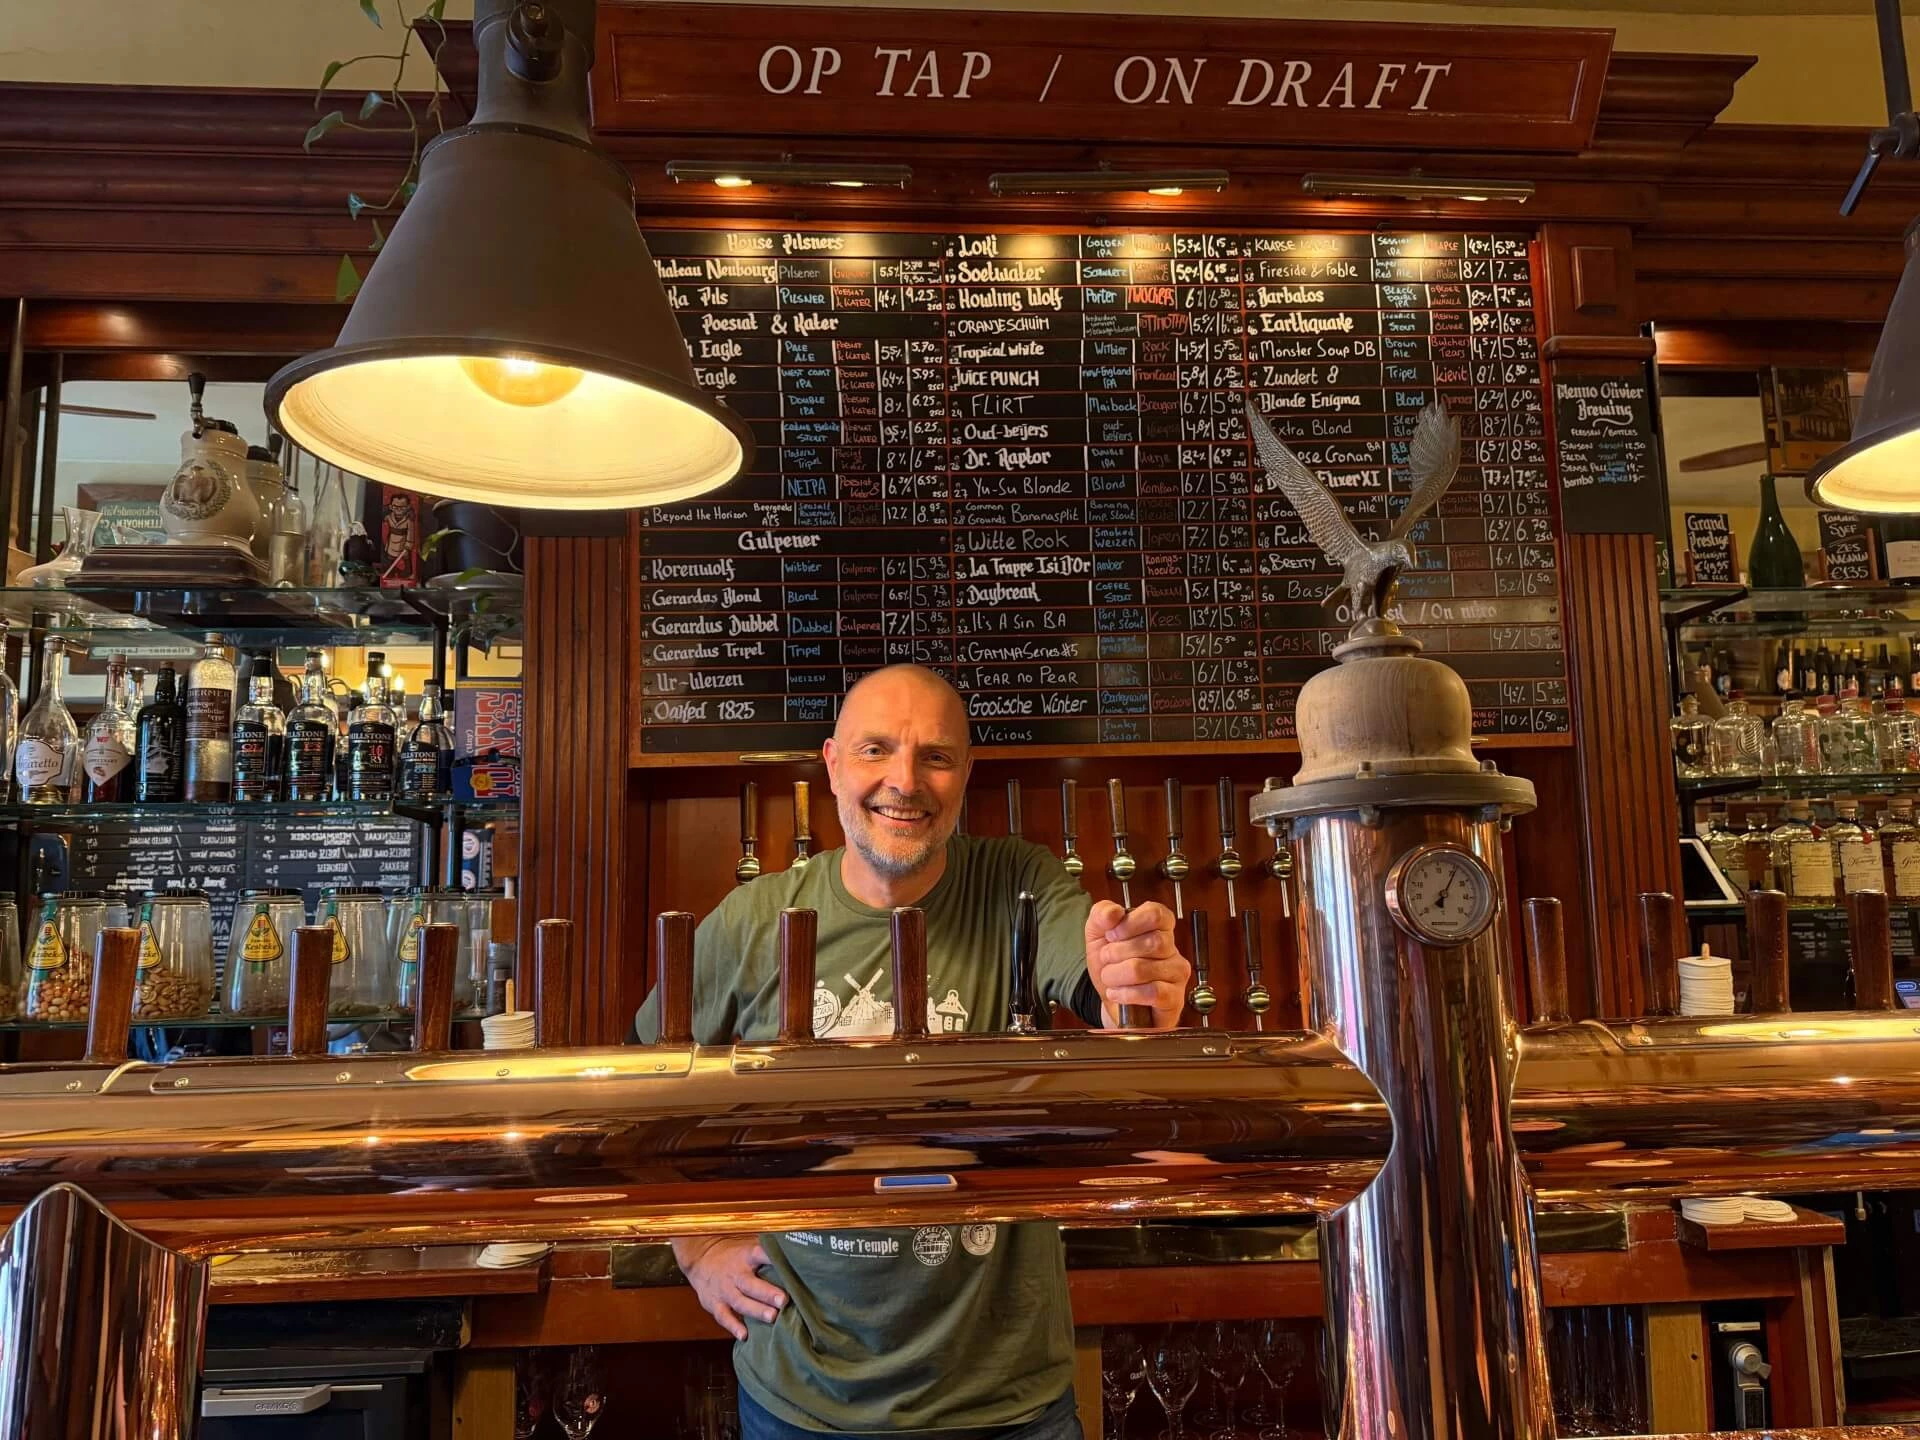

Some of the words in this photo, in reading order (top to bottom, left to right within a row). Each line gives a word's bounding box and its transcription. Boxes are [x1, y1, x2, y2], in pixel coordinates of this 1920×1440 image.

[758, 45, 841, 95] OP
[875, 46, 991, 99] TAP
[1040, 54, 1063, 103] /
[1114, 55, 1207, 105] ON
[1228, 59, 1452, 111] DRAFT
[727, 233, 773, 251] House
[783, 233, 844, 254] Pilsners
[1086, 237, 1125, 248] GOLDEN
[1255, 239, 1296, 252] KAAPSE
[653, 259, 702, 279] hateau
[706, 258, 775, 284] Neubourg
[779, 265, 820, 279] Pilsener
[958, 261, 1045, 283] Soetwater
[1260, 261, 1307, 278] Fireside
[1310, 262, 1324, 278] &
[1326, 261, 1358, 278] Fable
[697, 286, 728, 306] Pils
[780, 288, 825, 304] PILSNER
[958, 287, 1023, 312] Howling
[1026, 286, 1063, 311] Wolf
[1086, 288, 1117, 304] Porter
[1257, 286, 1325, 308] Barbatos
[702, 312, 758, 335] Poesiat
[771, 314, 787, 334] &
[793, 312, 839, 336] Kater
[1260, 312, 1354, 334] Earthquake
[699, 339, 743, 362] Eagle
[954, 341, 1007, 364] Tropical
[1008, 340, 1044, 356] white
[1142, 340, 1170, 351] ROCK
[1261, 340, 1312, 359] Monster
[1317, 338, 1350, 358] Soup
[1354, 341, 1376, 358] DB
[1385, 339, 1417, 348] Brown
[795, 354, 816, 363] ALE
[1144, 353, 1167, 362] CITY
[1393, 350, 1411, 358] Ale
[694, 366, 737, 389] Eagle
[990, 370, 1040, 387] PUNCH
[1263, 366, 1318, 387] Zundert
[1327, 365, 1339, 384] 8
[1386, 365, 1416, 382] Tripel
[796, 380, 813, 389] IPA
[1556, 384, 1598, 399] Menno
[1601, 382, 1644, 398] Olivier
[788, 394, 825, 404] DOUBLE
[1089, 398, 1137, 413] Maibock
[1258, 393, 1306, 413] Blonde
[1311, 392, 1361, 412] Enigma
[1396, 392, 1424, 406] Blond
[800, 406, 815, 416] IPA
[1576, 398, 1633, 427] Brewing
[964, 423, 1048, 441] Oud-beijers
[1312, 418, 1352, 437] Blond
[1366, 441, 1380, 452] BA
[1560, 440, 1593, 450] SAISON
[963, 448, 991, 470] Dr.
[995, 447, 1051, 471] Raptor
[788, 477, 827, 496] NEIPA
[973, 477, 1017, 498] Yu-Su
[1023, 476, 1072, 494] Blonde
[1091, 475, 1125, 491] Blond
[753, 502, 793, 512] Beergeeks
[887, 507, 908, 521] 12%
[965, 502, 1004, 512] Common
[1011, 503, 1080, 524] Bananasplit
[1090, 501, 1129, 510] Banana
[1181, 500, 1209, 520] 12%
[1358, 501, 1377, 513] Ale
[653, 506, 693, 524] Beyond
[696, 507, 711, 521] the
[714, 506, 748, 520] Horizon
[762, 518, 780, 526] ALS
[967, 514, 1007, 525] Grounds
[1110, 510, 1136, 520] Stout
[1687, 514, 1727, 531] Grand
[1095, 527, 1134, 537] Smoked
[1829, 523, 1857, 538] SJEF
[738, 530, 821, 554] Gulpener
[968, 530, 1016, 551] Witte
[1022, 528, 1069, 551] Rook
[1688, 531, 1729, 552] Prestige
[652, 558, 736, 582] Korenwolf
[842, 562, 878, 577] Gulpener
[969, 556, 989, 578] La
[989, 557, 1034, 578] Trappe
[1831, 566, 1869, 580] €135
[652, 588, 718, 606] Gerardus
[721, 587, 762, 609] Blond
[788, 589, 819, 604] Blond
[966, 582, 1042, 606] Daybreak
[1431, 603, 1455, 620] On
[652, 615, 723, 635] Gerardus
[728, 613, 779, 636] Dubbel
[792, 616, 833, 634] Dubbel
[973, 611, 992, 631] It's
[1000, 612, 1008, 630] A
[1014, 614, 1034, 629] Sin
[1118, 620, 1145, 630] Stout
[1272, 632, 1313, 651] CASK
[653, 643, 720, 661] Gerardus
[721, 641, 766, 659] Tripel
[787, 644, 821, 658] Tripel
[790, 675, 826, 683] WEIZEN
[1017, 673, 1033, 684] no
[654, 700, 708, 723] Oaked
[718, 700, 756, 720] 1825
[968, 693, 1033, 717] Gooische
[1040, 692, 1088, 714] Winter
[799, 708, 824, 720] blond
[1276, 716, 1293, 725] ON
[1504, 714, 1528, 725] 10%
[976, 725, 1033, 742] Vicious
[830, 1236, 855, 1252] Beer
[856, 1238, 899, 1254] Temple
